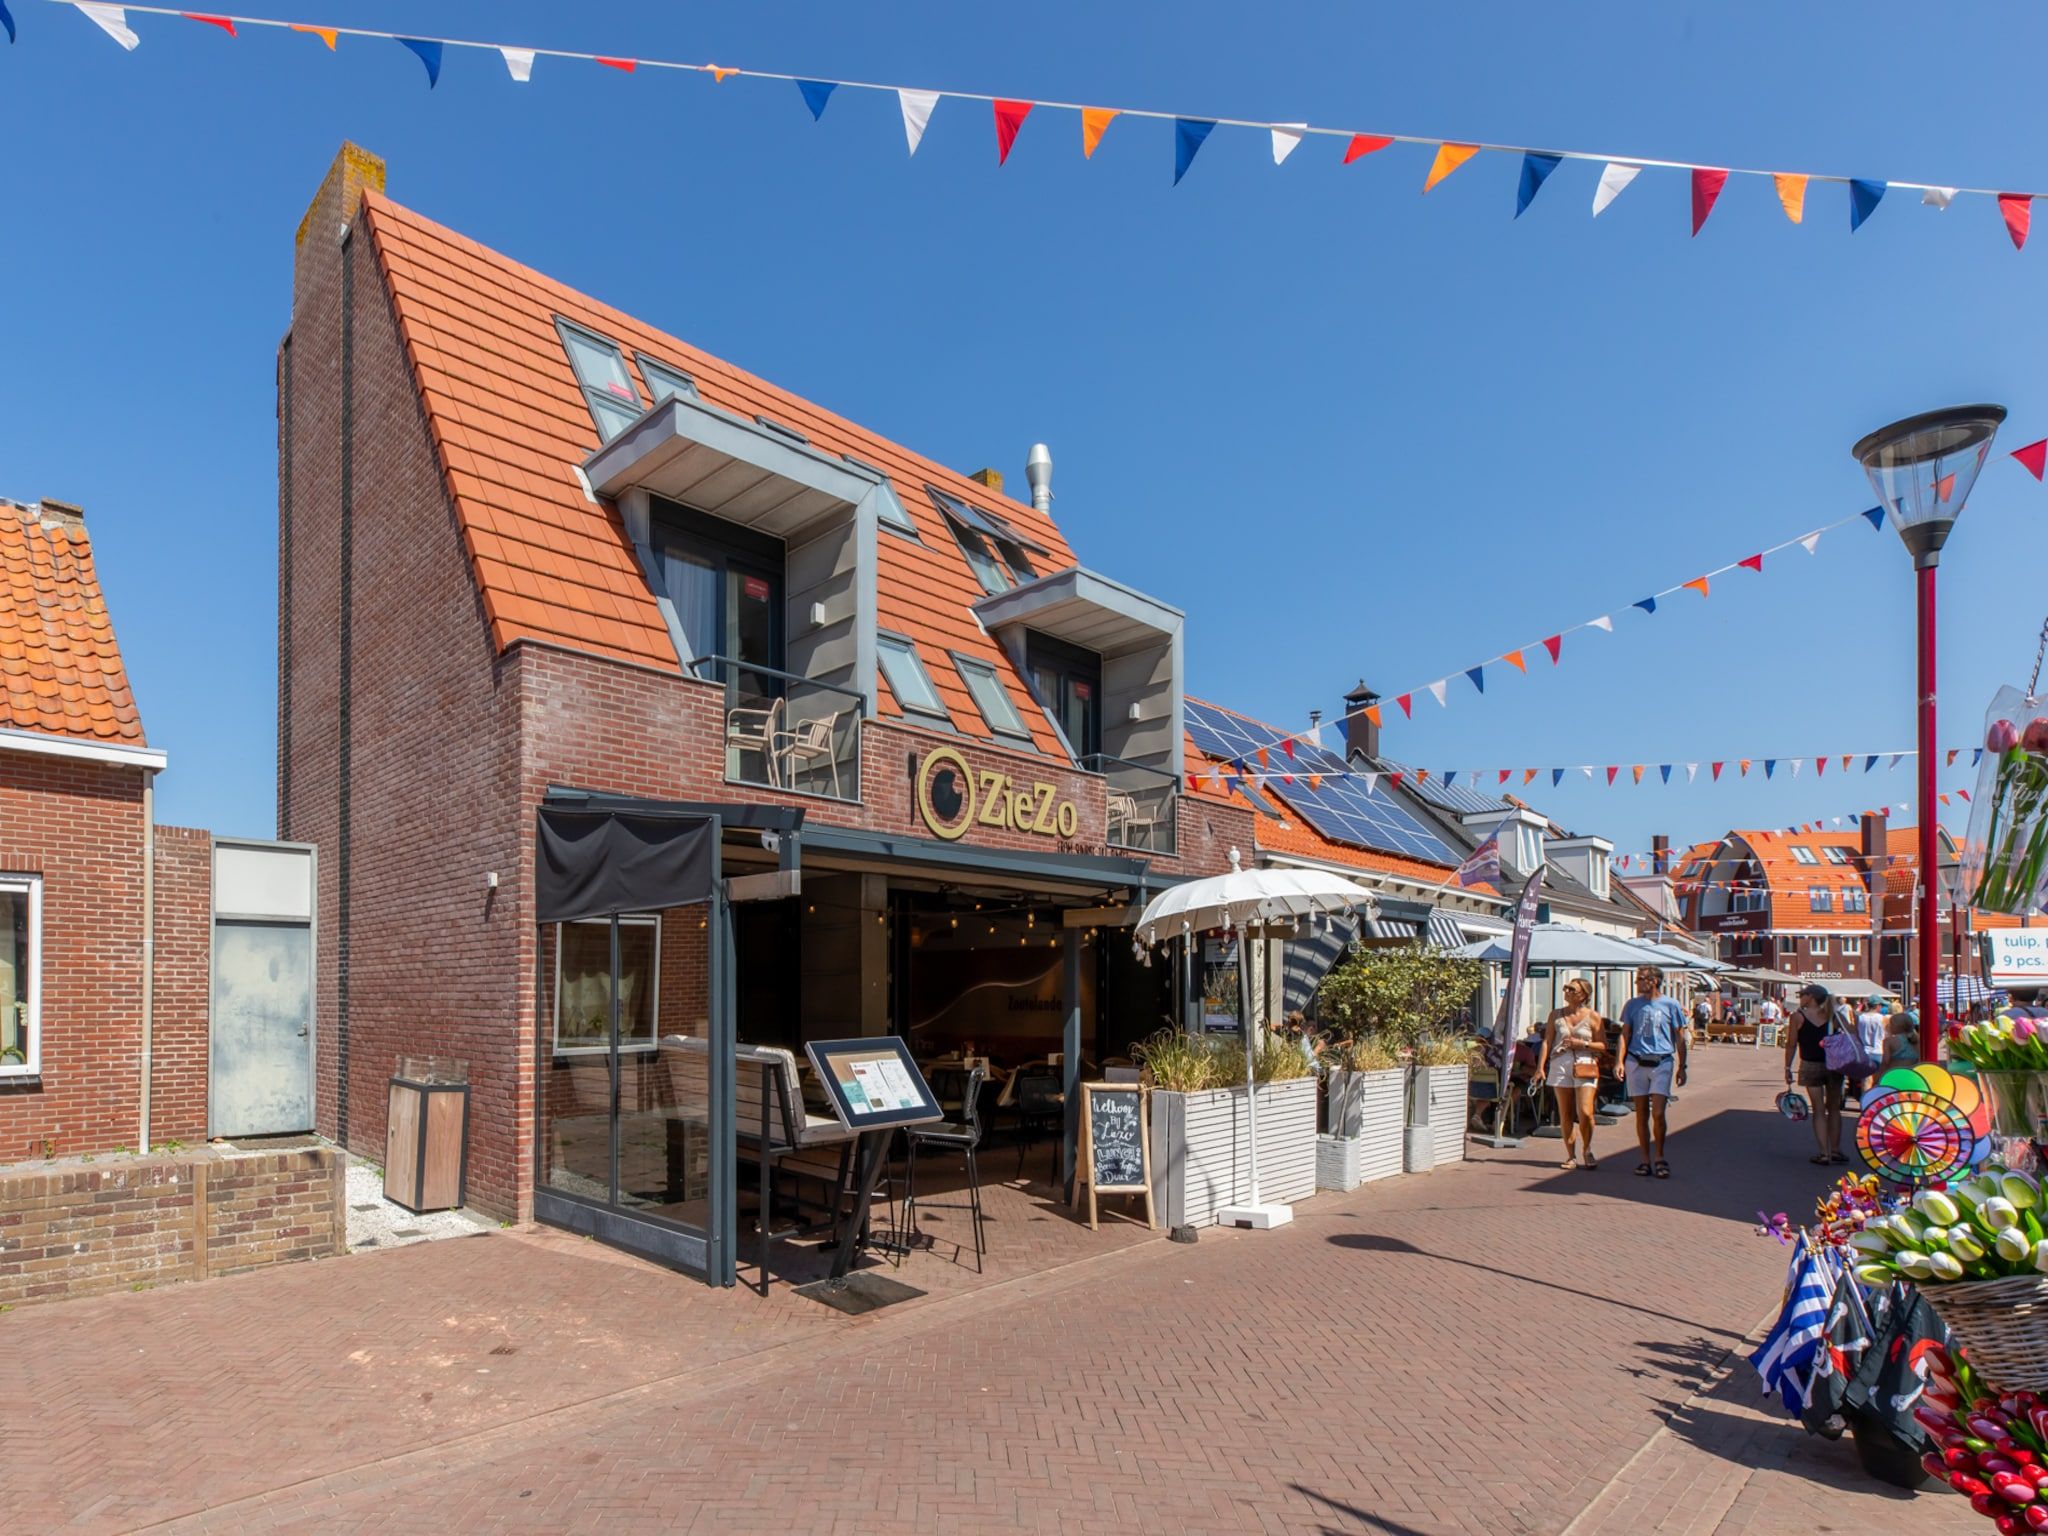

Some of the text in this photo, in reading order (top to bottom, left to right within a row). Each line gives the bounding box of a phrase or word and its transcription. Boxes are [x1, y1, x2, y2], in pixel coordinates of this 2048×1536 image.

[978, 770, 1078, 838] ZieZo
[2003, 955, 2045, 968] 9 pcs.
